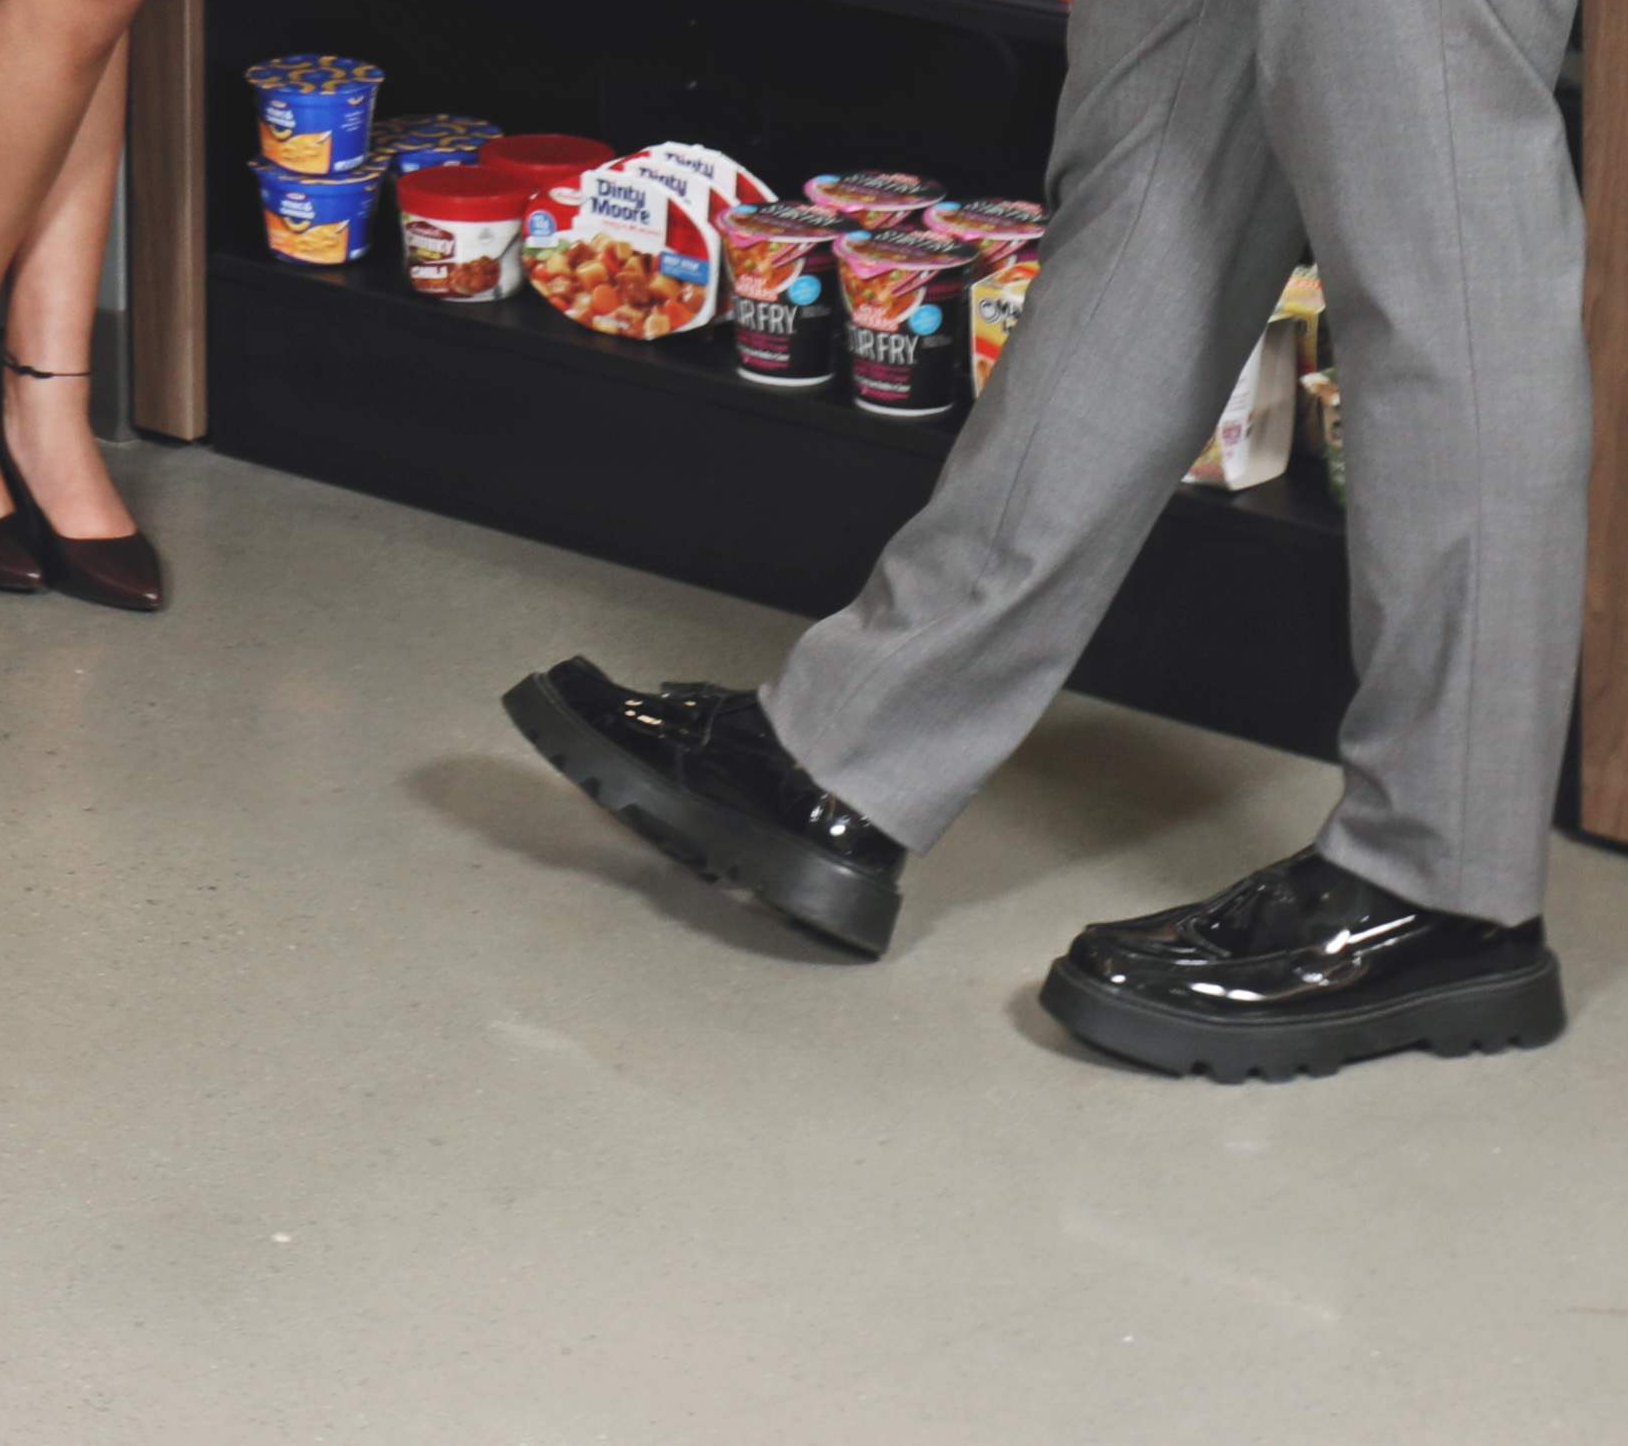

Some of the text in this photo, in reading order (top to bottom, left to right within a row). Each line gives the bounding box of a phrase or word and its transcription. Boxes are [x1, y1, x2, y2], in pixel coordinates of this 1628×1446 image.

[597, 179, 646, 208] Dinty
[590, 197, 650, 225] Moore
[758, 305, 798, 335] FRY
[878, 334, 920, 365] FRY
